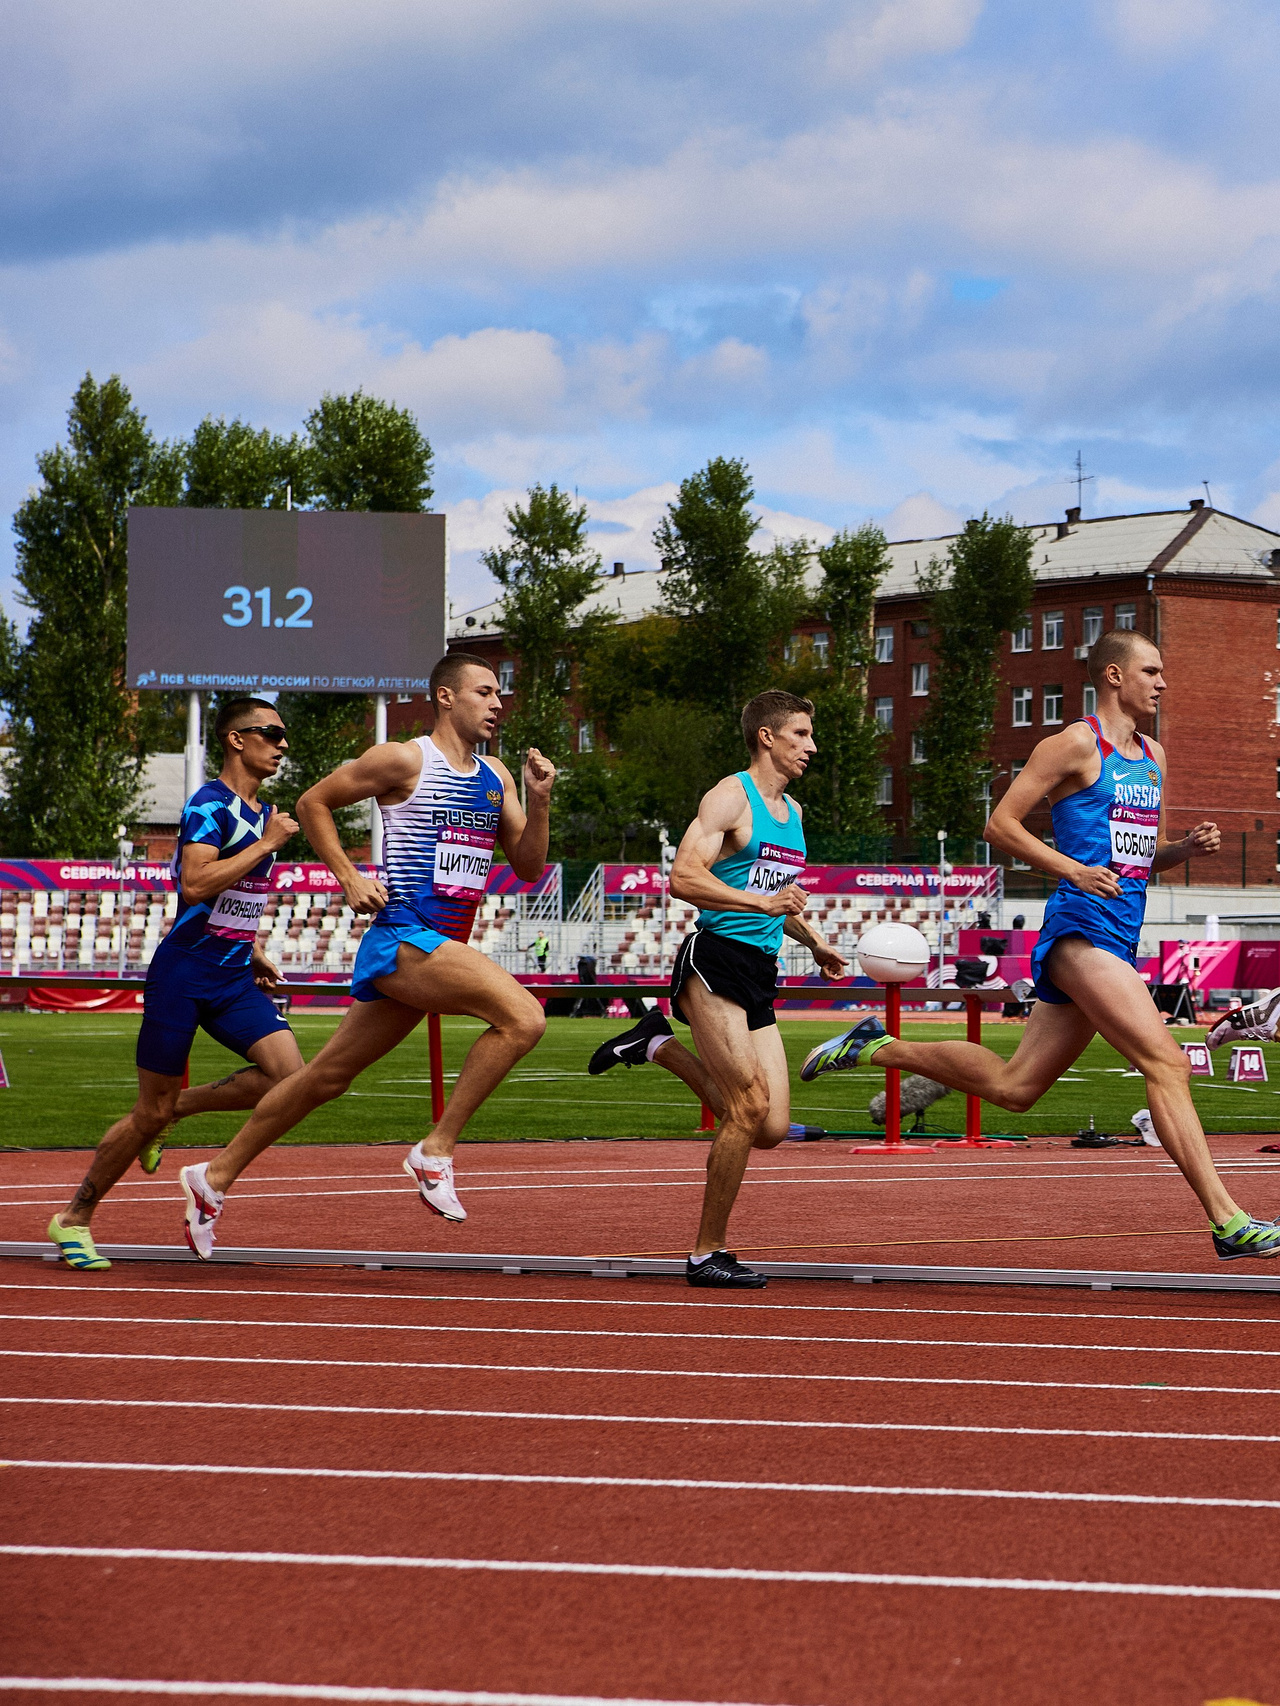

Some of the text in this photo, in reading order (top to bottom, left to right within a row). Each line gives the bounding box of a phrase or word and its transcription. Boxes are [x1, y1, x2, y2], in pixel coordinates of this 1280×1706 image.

[222, 586, 313, 628] 31.2
[160, 674, 430, 690] ПСБ ЧЕМПИОНАТ РОССИИ ПО ЛЕГКОЙ АТЛЕТИКЕ
[453, 832, 470, 842] ПСБ
[439, 851, 490, 877] ЦИТУЛЕВ
[60, 866, 136, 880] СЕВЕРНАЯ
[856, 874, 986, 888] СЕВЕРНАЯ ТРИБУНА
[1187, 1049, 1206, 1066] 16
[1241, 1053, 1261, 1072] 14
